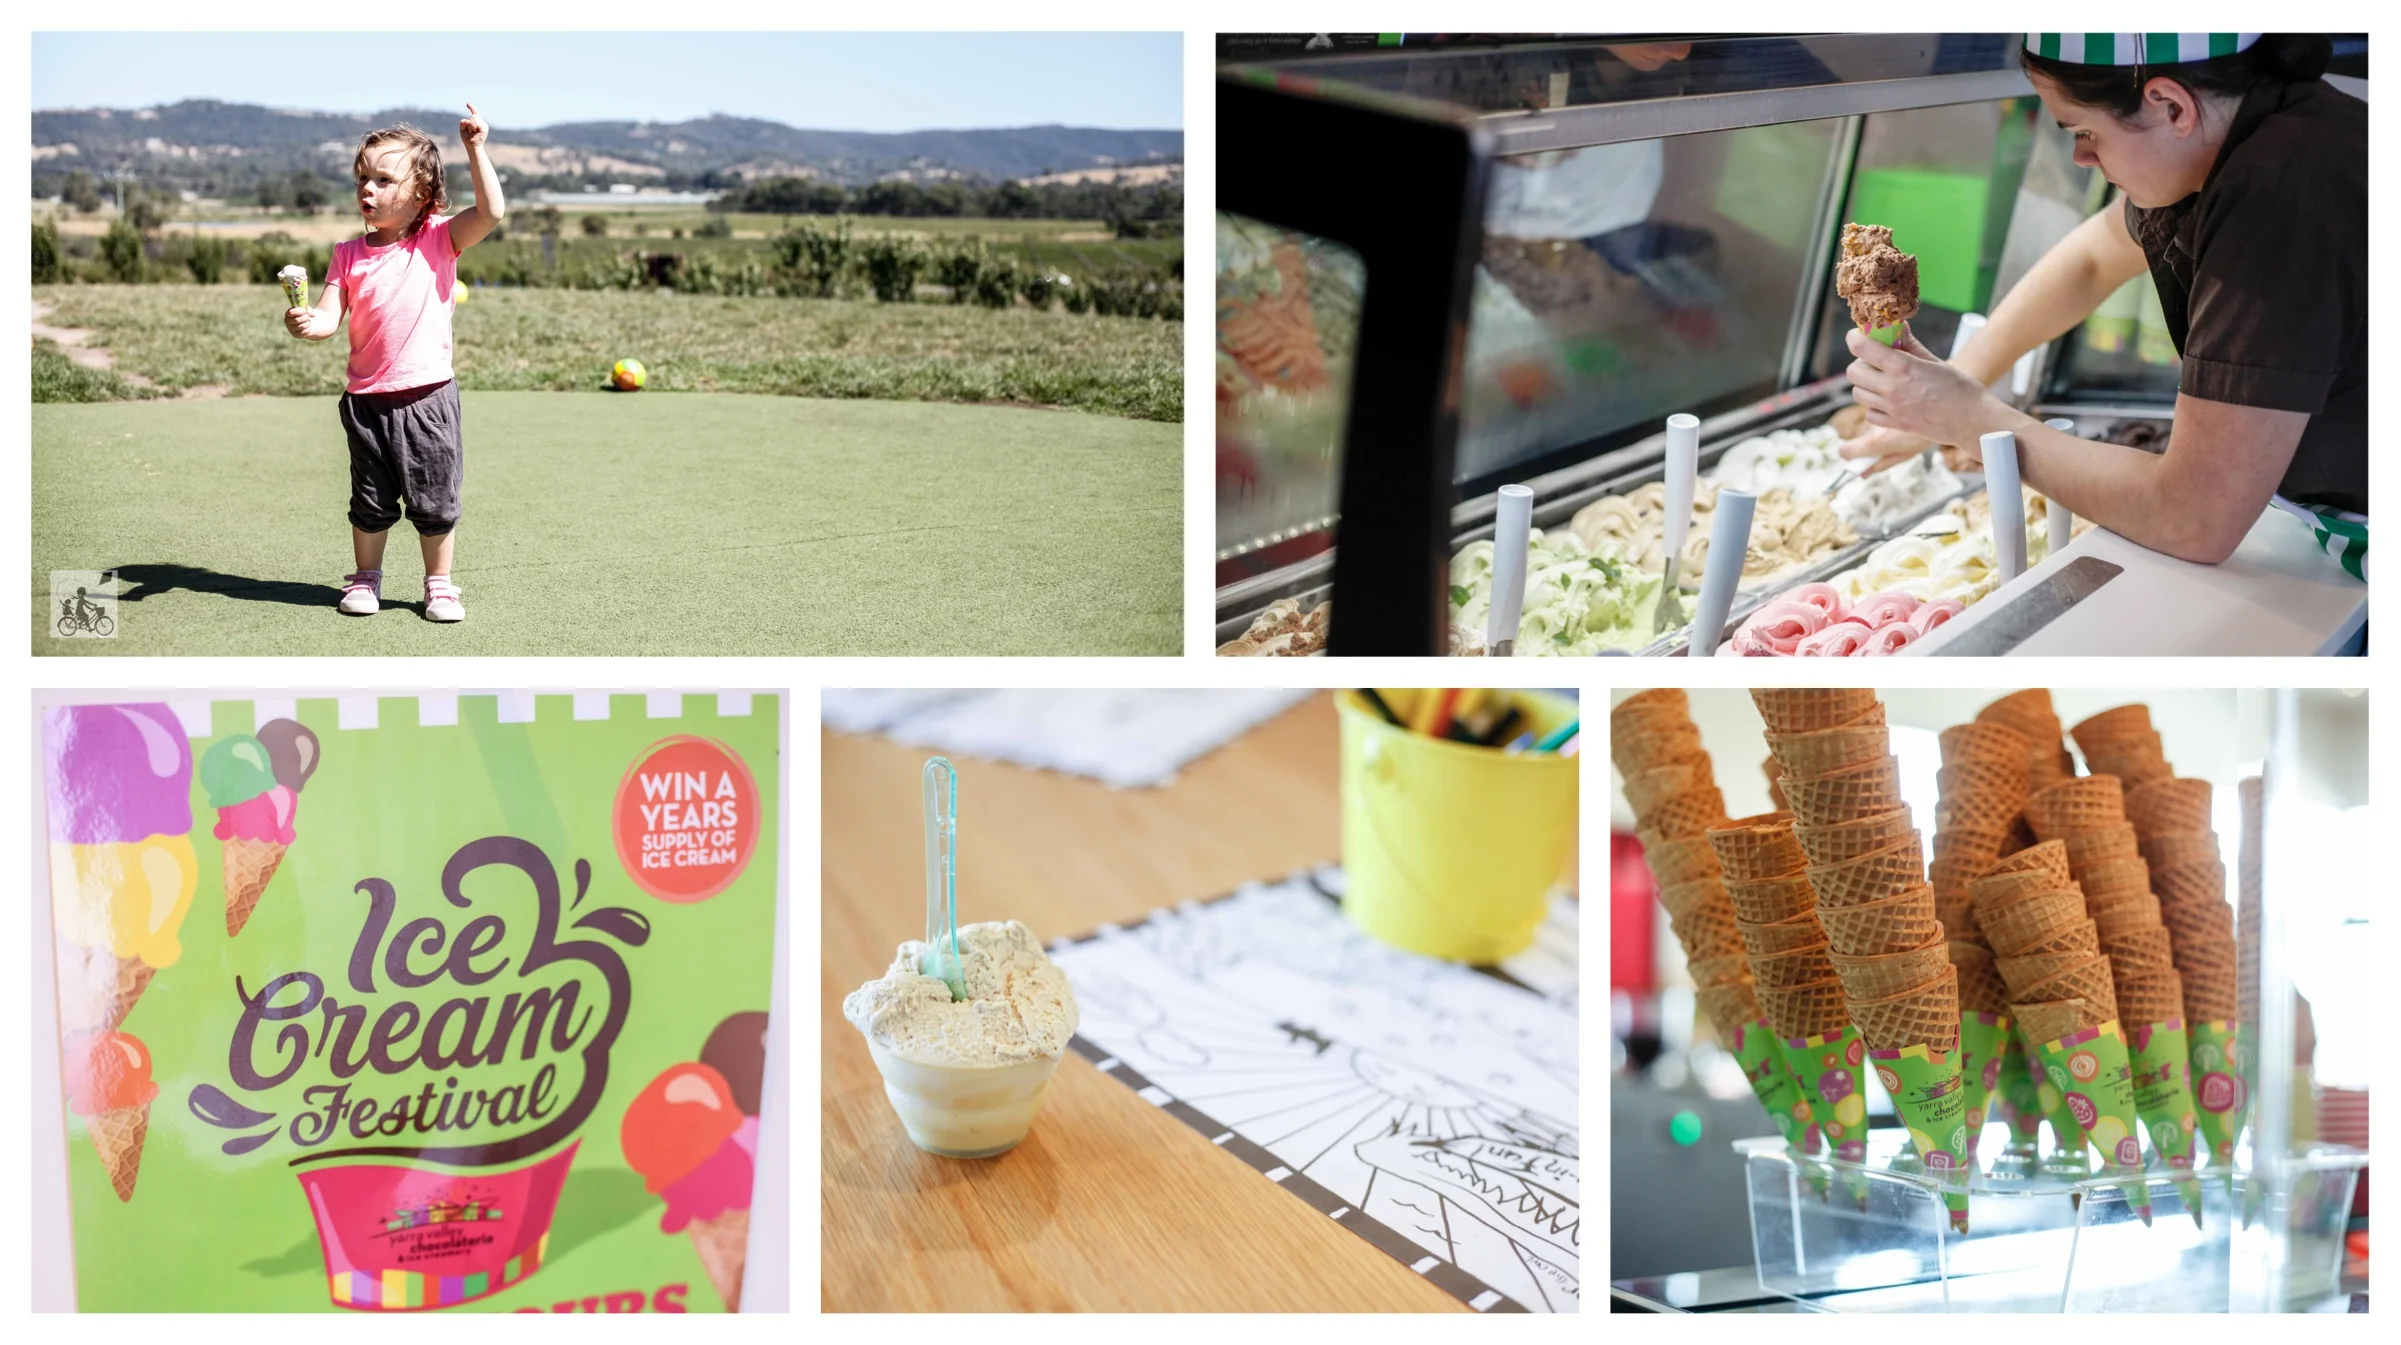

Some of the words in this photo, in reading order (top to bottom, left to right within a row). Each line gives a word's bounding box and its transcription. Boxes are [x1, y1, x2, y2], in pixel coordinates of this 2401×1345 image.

[639, 771, 707, 802] WIN
[714, 769, 737, 800] A
[639, 800, 738, 832] YEARS
[641, 832, 708, 851] SUPPLY
[711, 829, 736, 847] OF
[641, 850, 671, 869] ICE
[674, 848, 737, 867] CREAM
[348, 877, 511, 994] Ice
[228, 971, 594, 1092] Cream
[289, 1062, 560, 1147] Festival
[389, 1231, 424, 1248] yarra
[426, 1224, 464, 1239] valley
